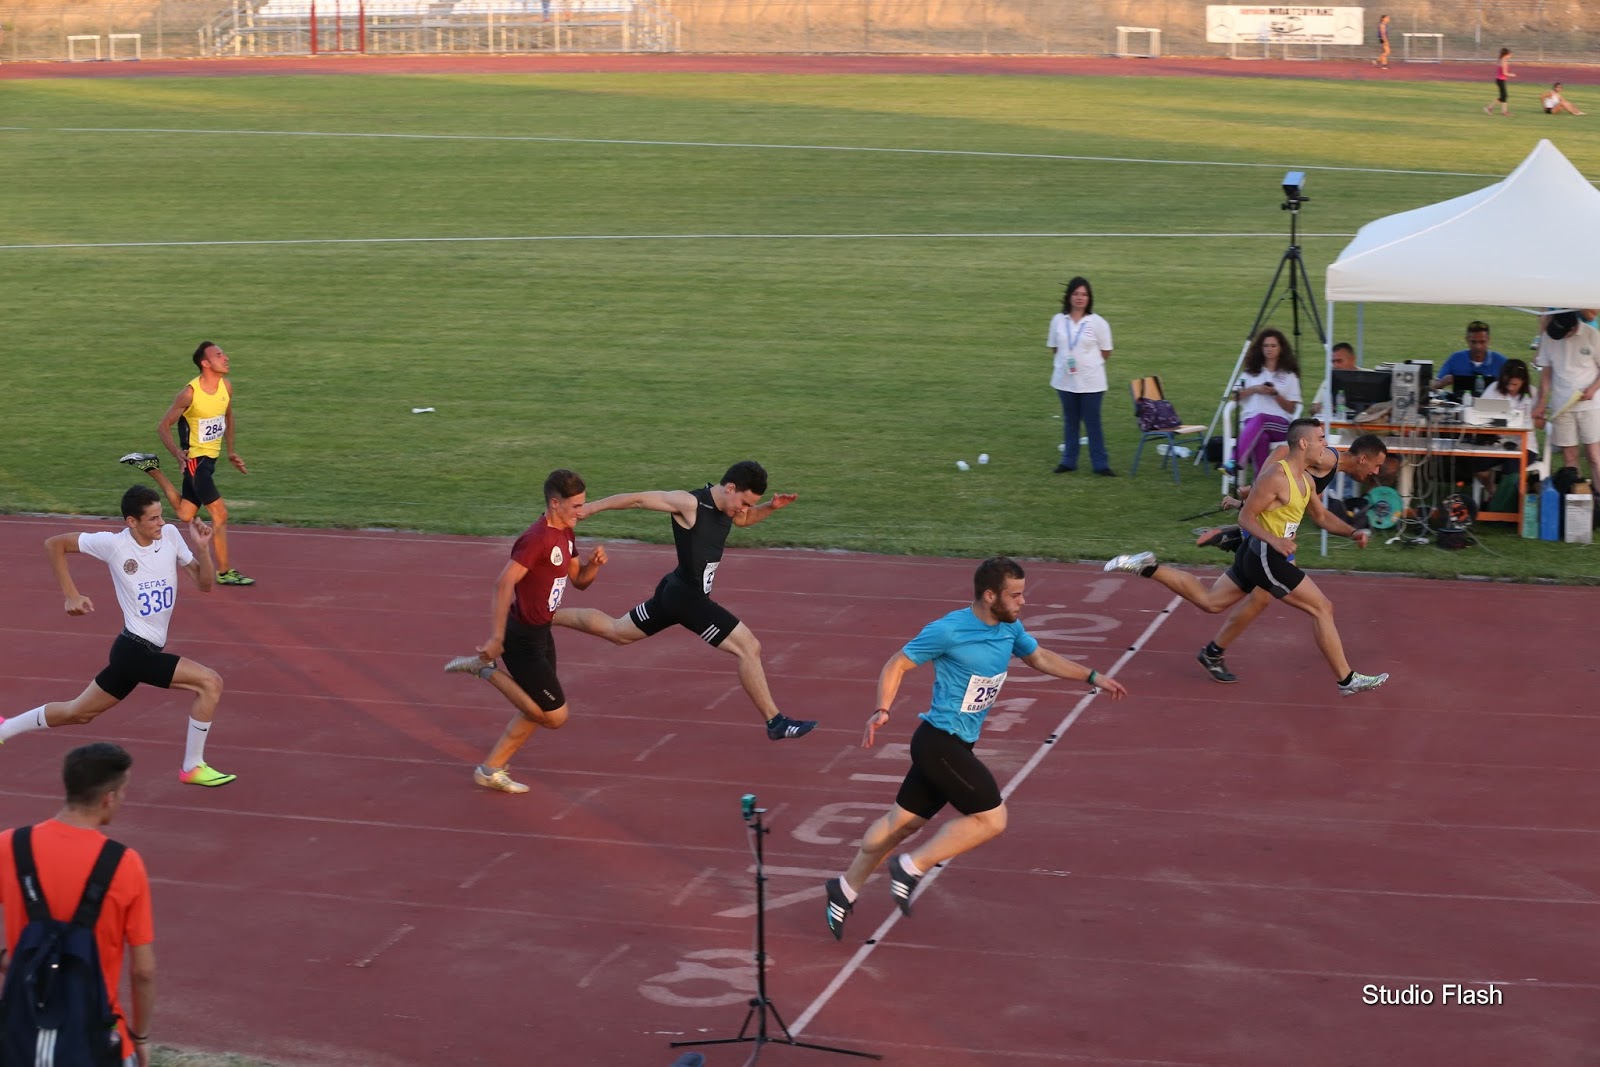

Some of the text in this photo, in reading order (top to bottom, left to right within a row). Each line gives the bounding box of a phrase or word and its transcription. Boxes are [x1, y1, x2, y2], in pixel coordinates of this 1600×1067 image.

[205, 422, 223, 436] 284
[138, 578, 167, 591] ΣΕΓΑΣ
[1081, 578, 1127, 603] 1
[137, 586, 173, 616] 330
[1023, 612, 1122, 642] 2
[637, 948, 776, 1008] 8
